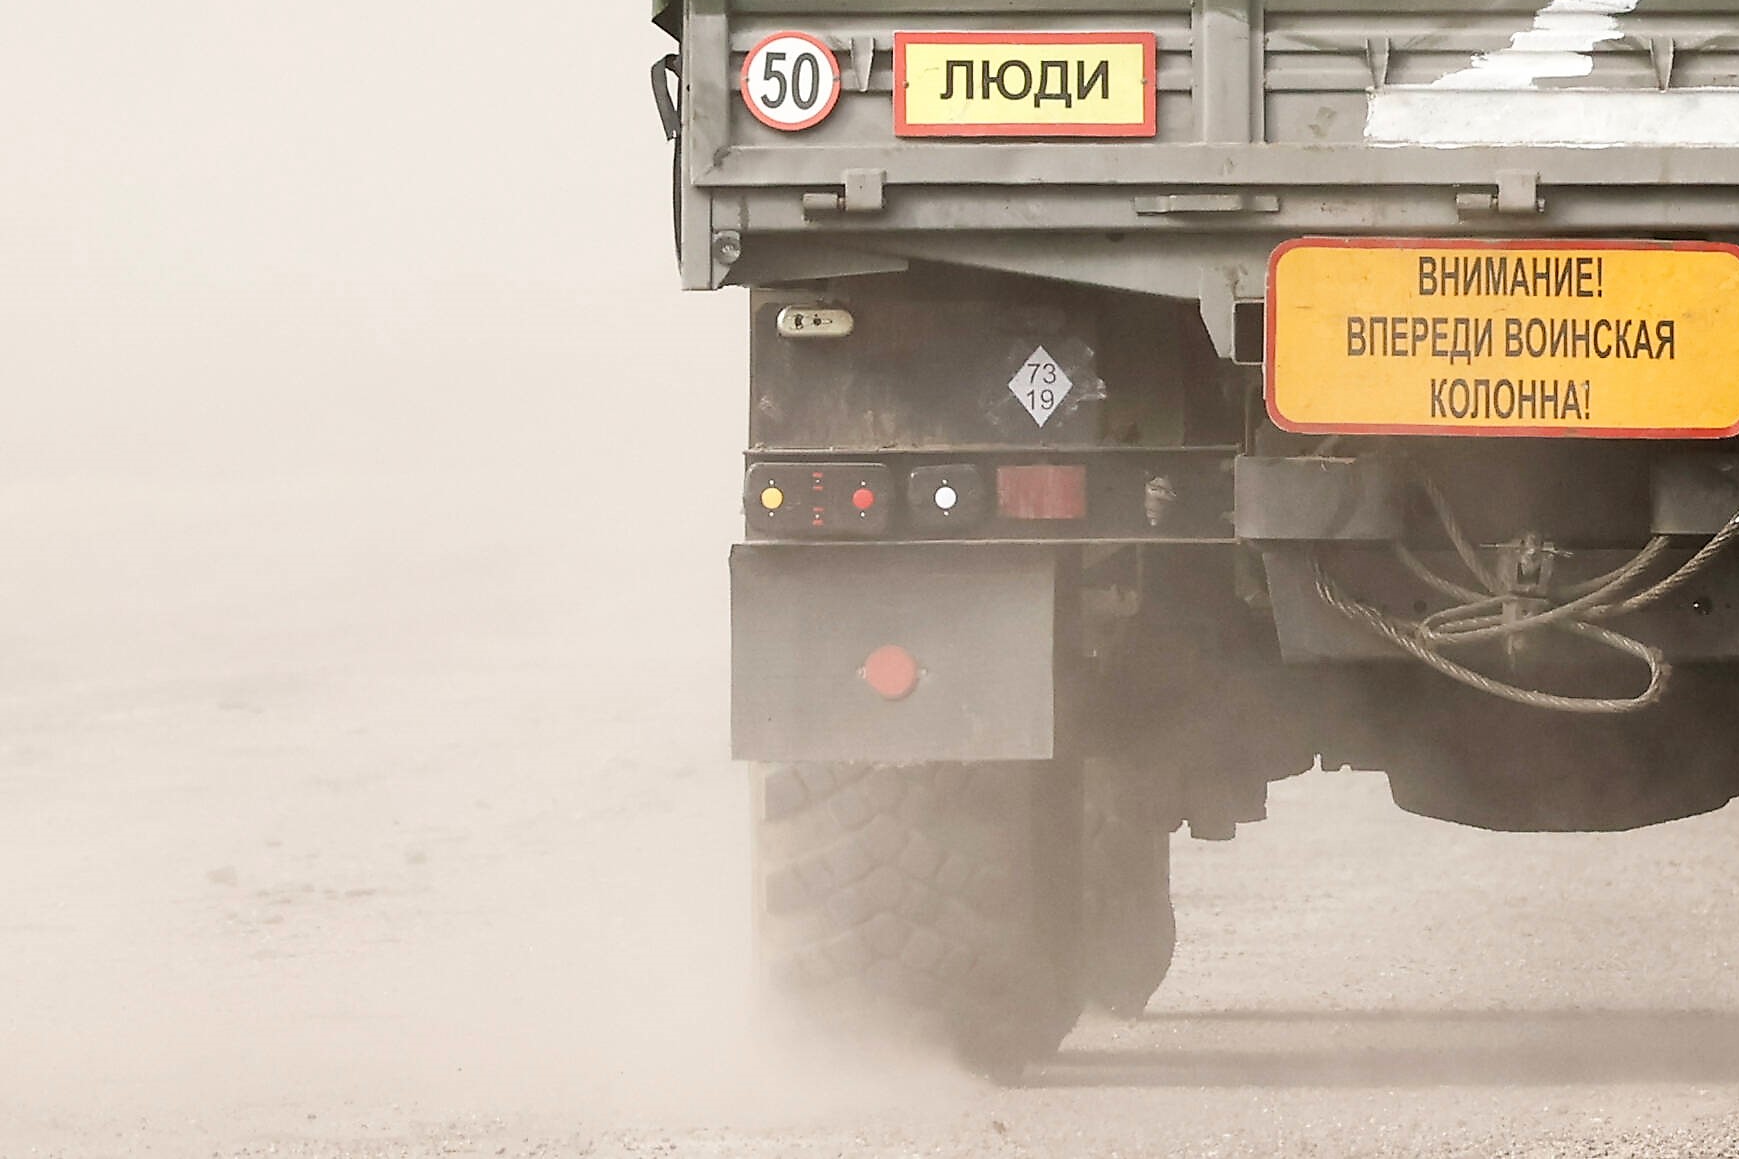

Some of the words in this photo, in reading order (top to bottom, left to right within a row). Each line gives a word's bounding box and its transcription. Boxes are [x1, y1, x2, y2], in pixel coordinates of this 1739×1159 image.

[760, 51, 820, 111] 50
[939, 59, 1110, 109] ЛЮДИ
[1418, 255, 1604, 299] ВНИМАНИЕ!
[1346, 315, 1494, 366] ВПЕРЕДИ
[1504, 317, 1676, 360] ВОИНСКАЯ
[1026, 362, 1057, 385] 73
[1026, 388, 1055, 410] 19
[1430, 377, 1592, 421] КОЛОННА!
